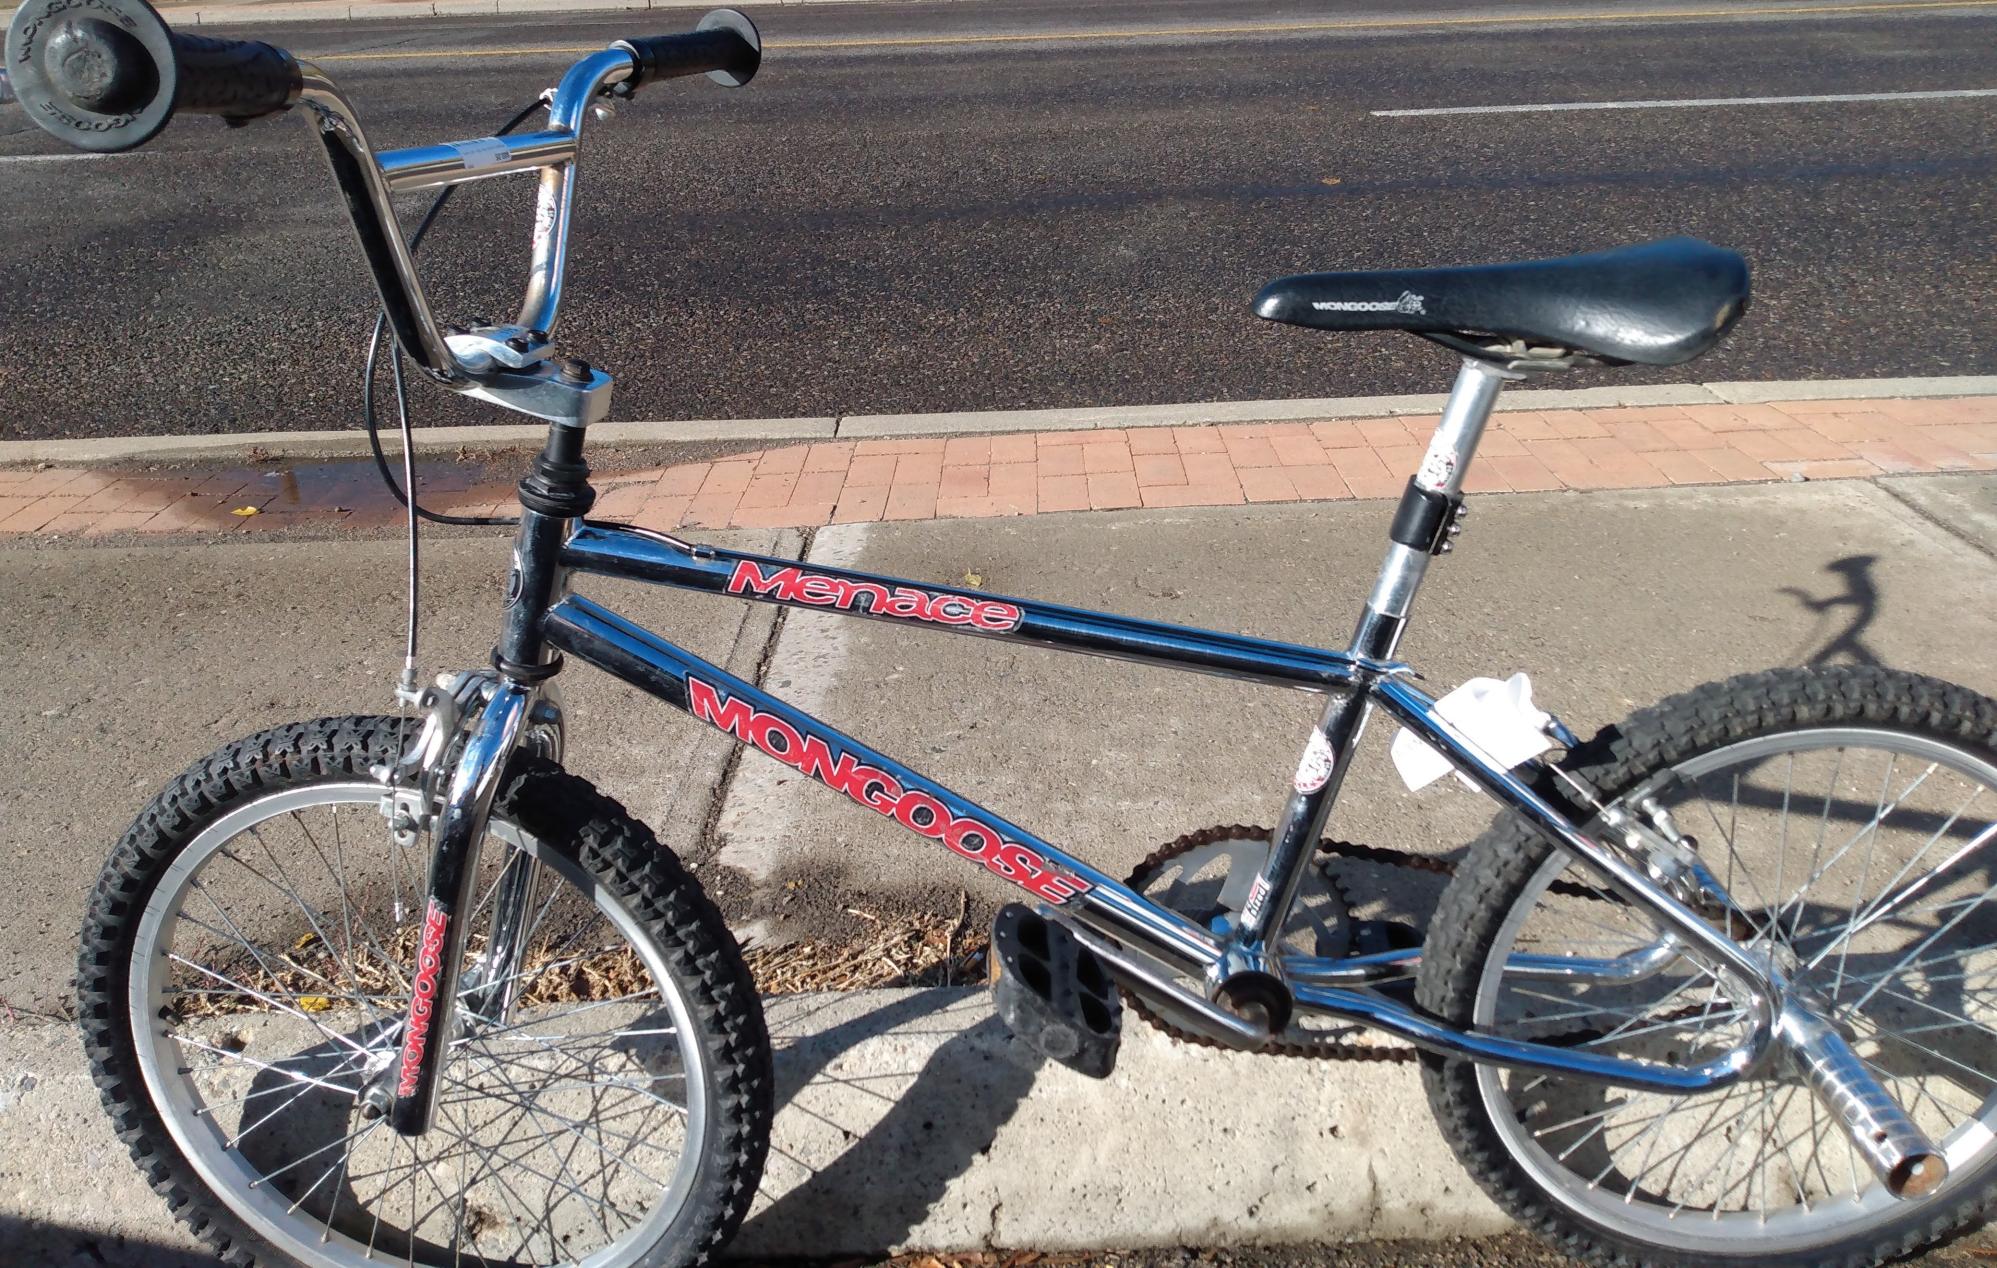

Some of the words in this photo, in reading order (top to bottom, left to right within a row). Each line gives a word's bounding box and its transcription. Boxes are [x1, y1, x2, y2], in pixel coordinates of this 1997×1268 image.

[1311, 301, 1398, 312] MONGOOSE
[727, 559, 1022, 631] Menace
[688, 676, 1096, 905] MONGOOSE
[398, 899, 448, 1097] MONGOOSE
